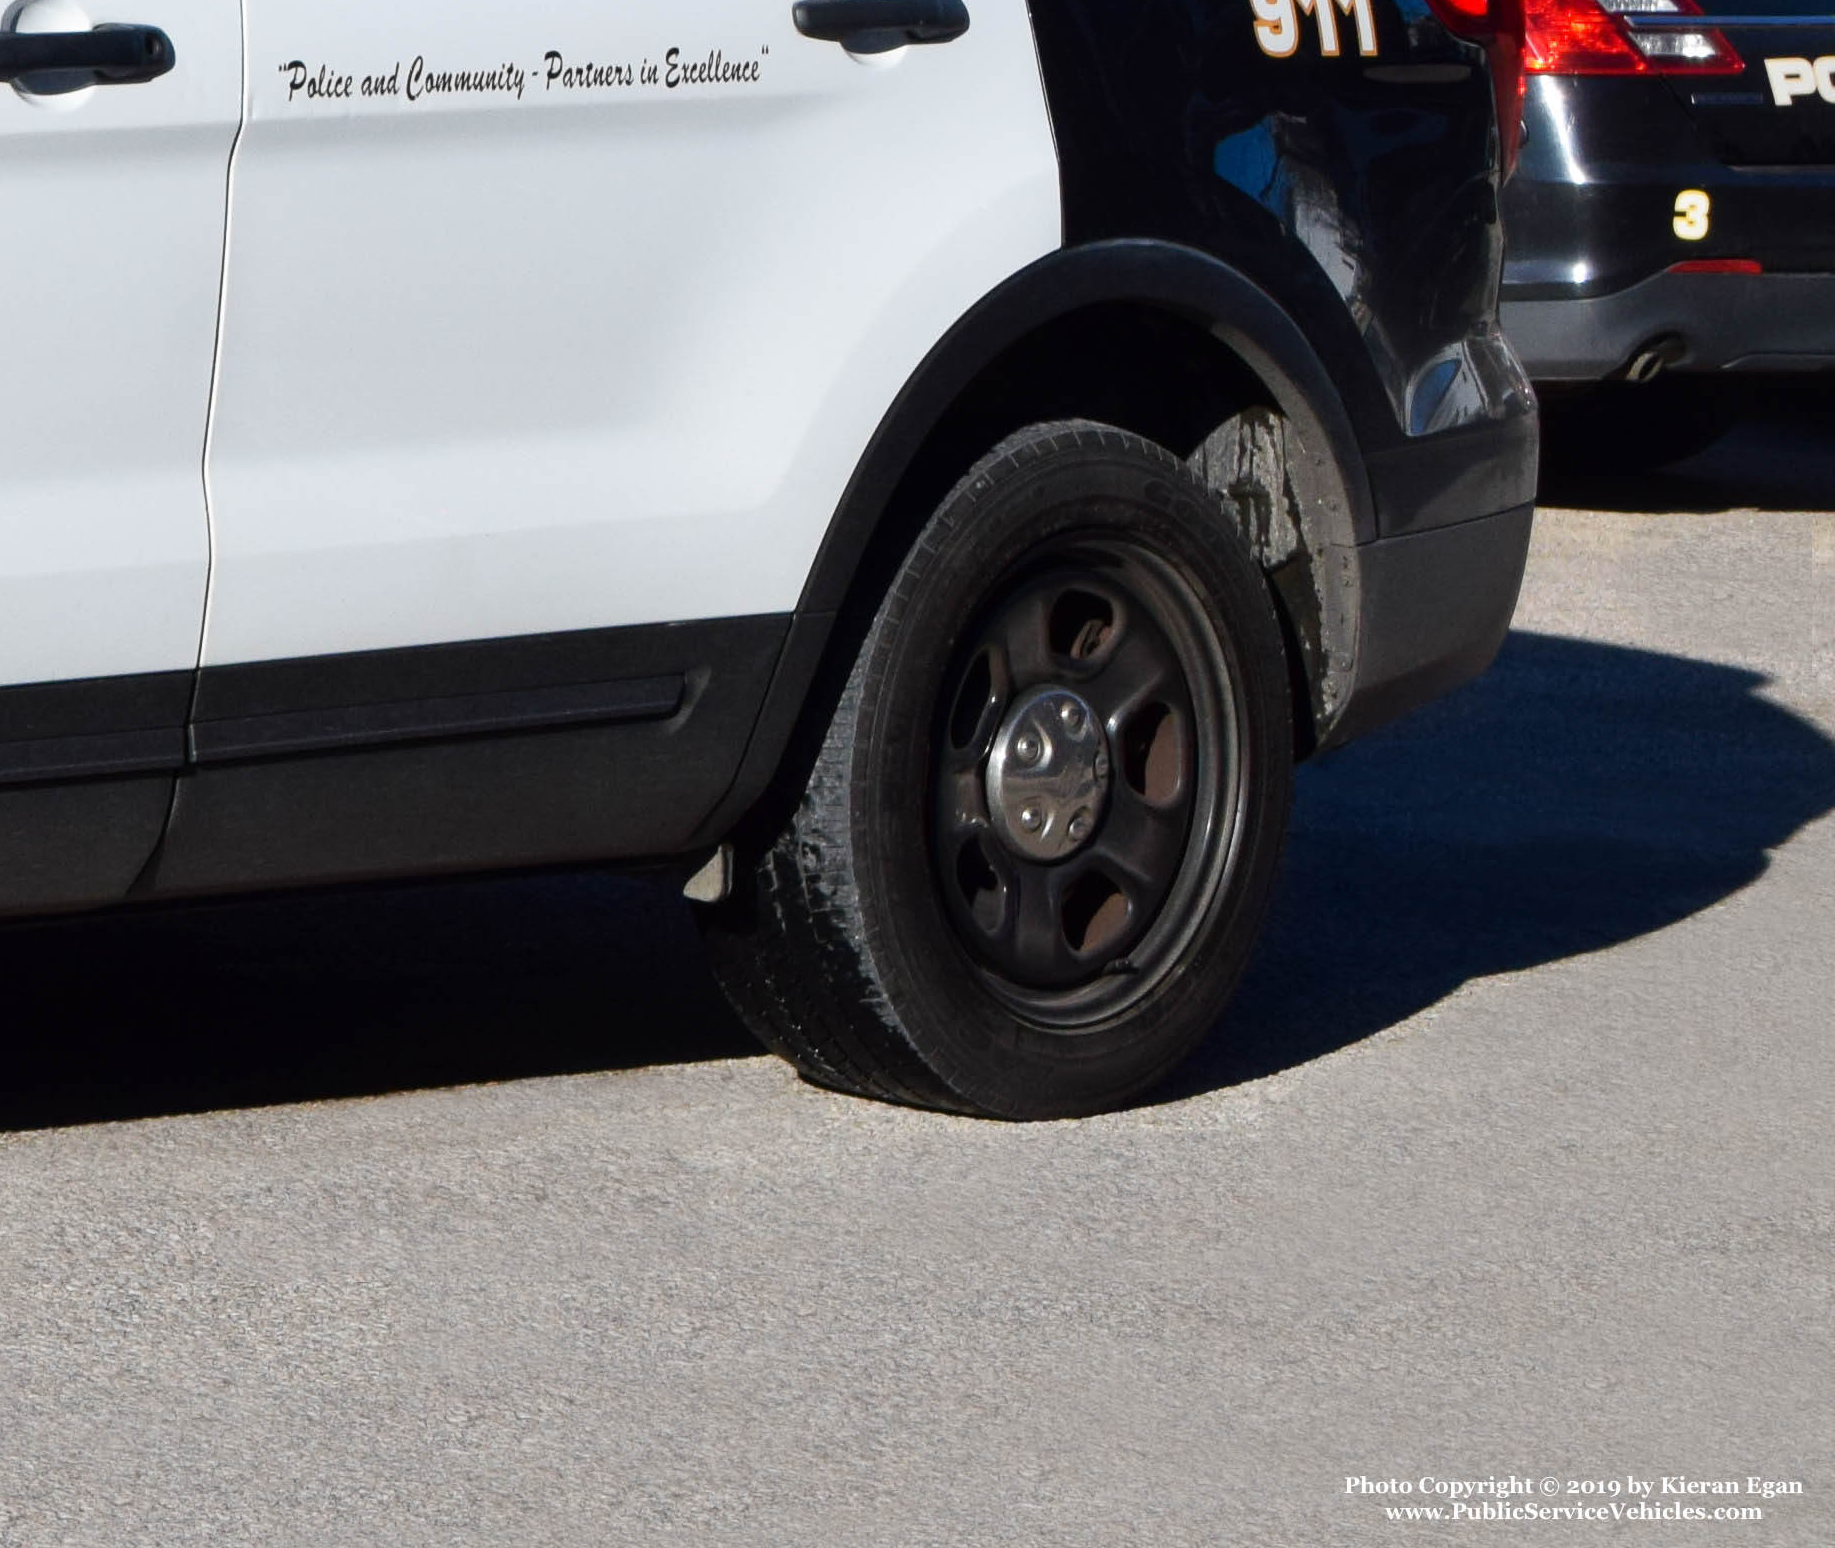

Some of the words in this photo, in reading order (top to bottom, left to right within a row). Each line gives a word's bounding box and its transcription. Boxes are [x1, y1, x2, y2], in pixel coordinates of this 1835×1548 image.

[360, 62, 401, 95] and
[405, 55, 526, 101] Community
[543, 49, 635, 92] Partners
[640, 56, 660, 86] in
[1672, 188, 1710, 242] 3
